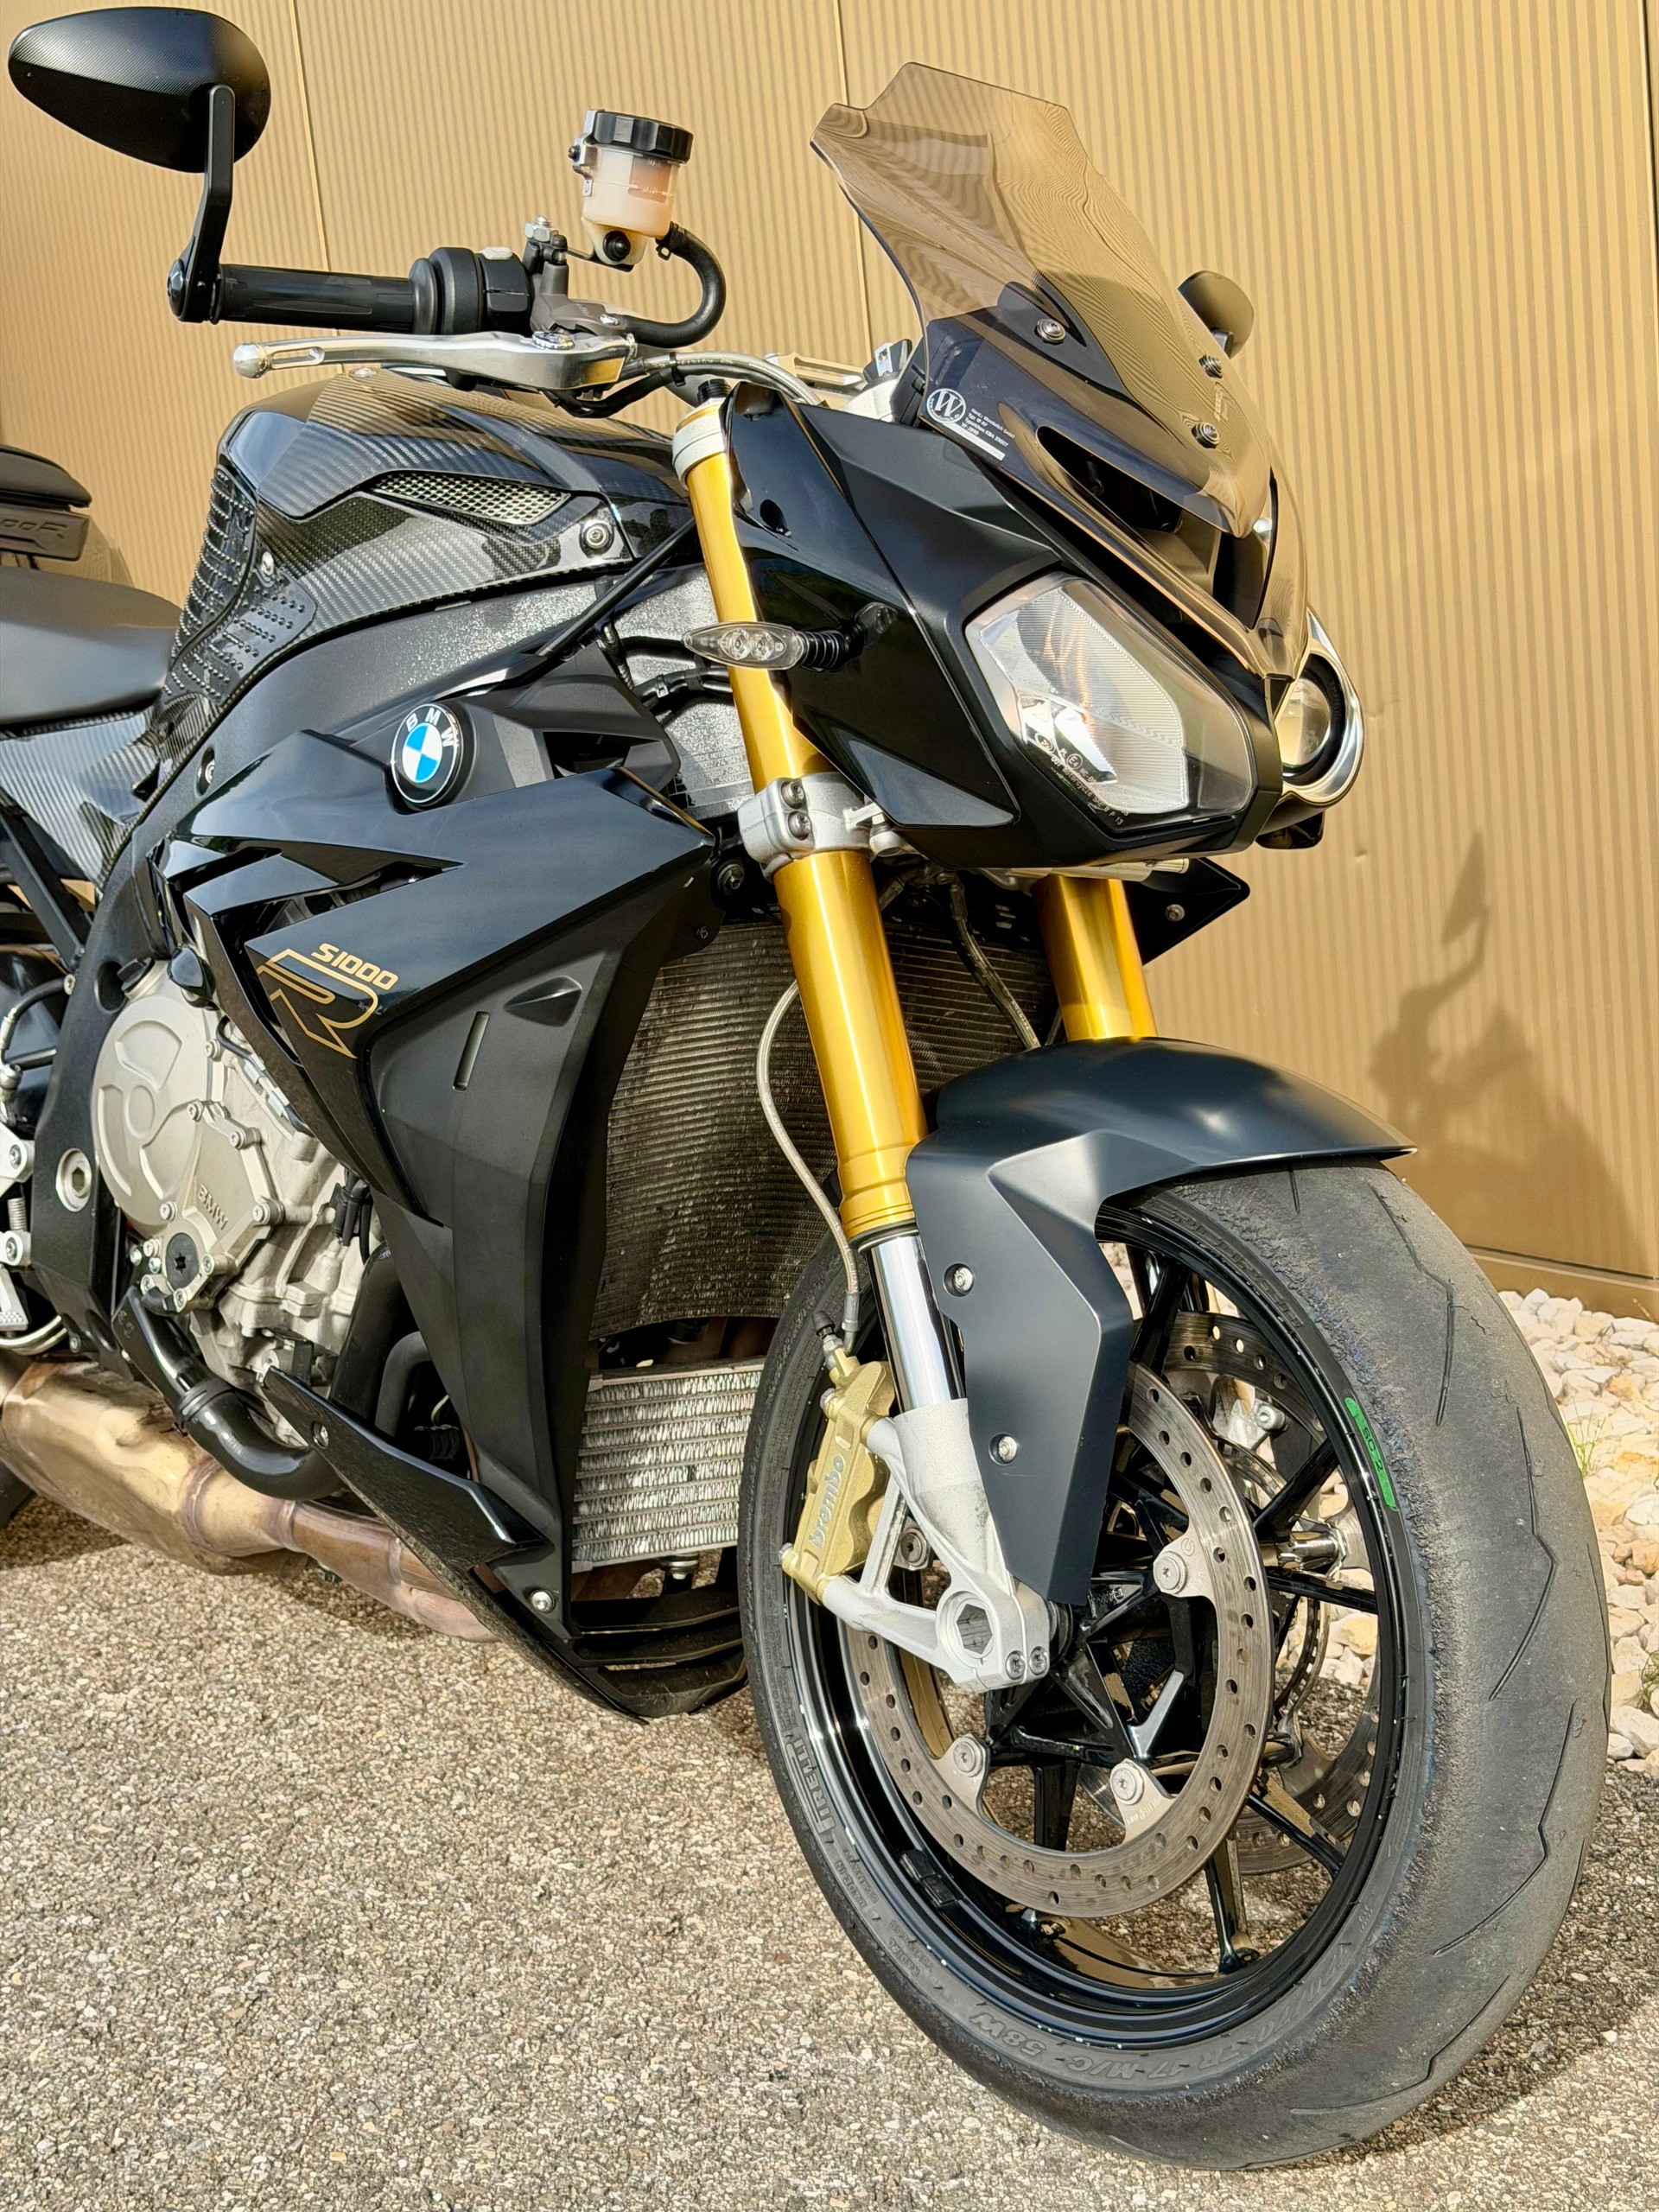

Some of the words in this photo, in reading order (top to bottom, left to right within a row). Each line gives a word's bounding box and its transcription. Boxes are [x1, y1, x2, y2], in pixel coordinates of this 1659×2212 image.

[405, 708, 460, 747] BMW
[311, 943, 399, 991] S1000
[199, 1183, 229, 1230] BMW
[808, 1455, 846, 1549] brembo
[785, 1738, 836, 1834] PIRELLI
